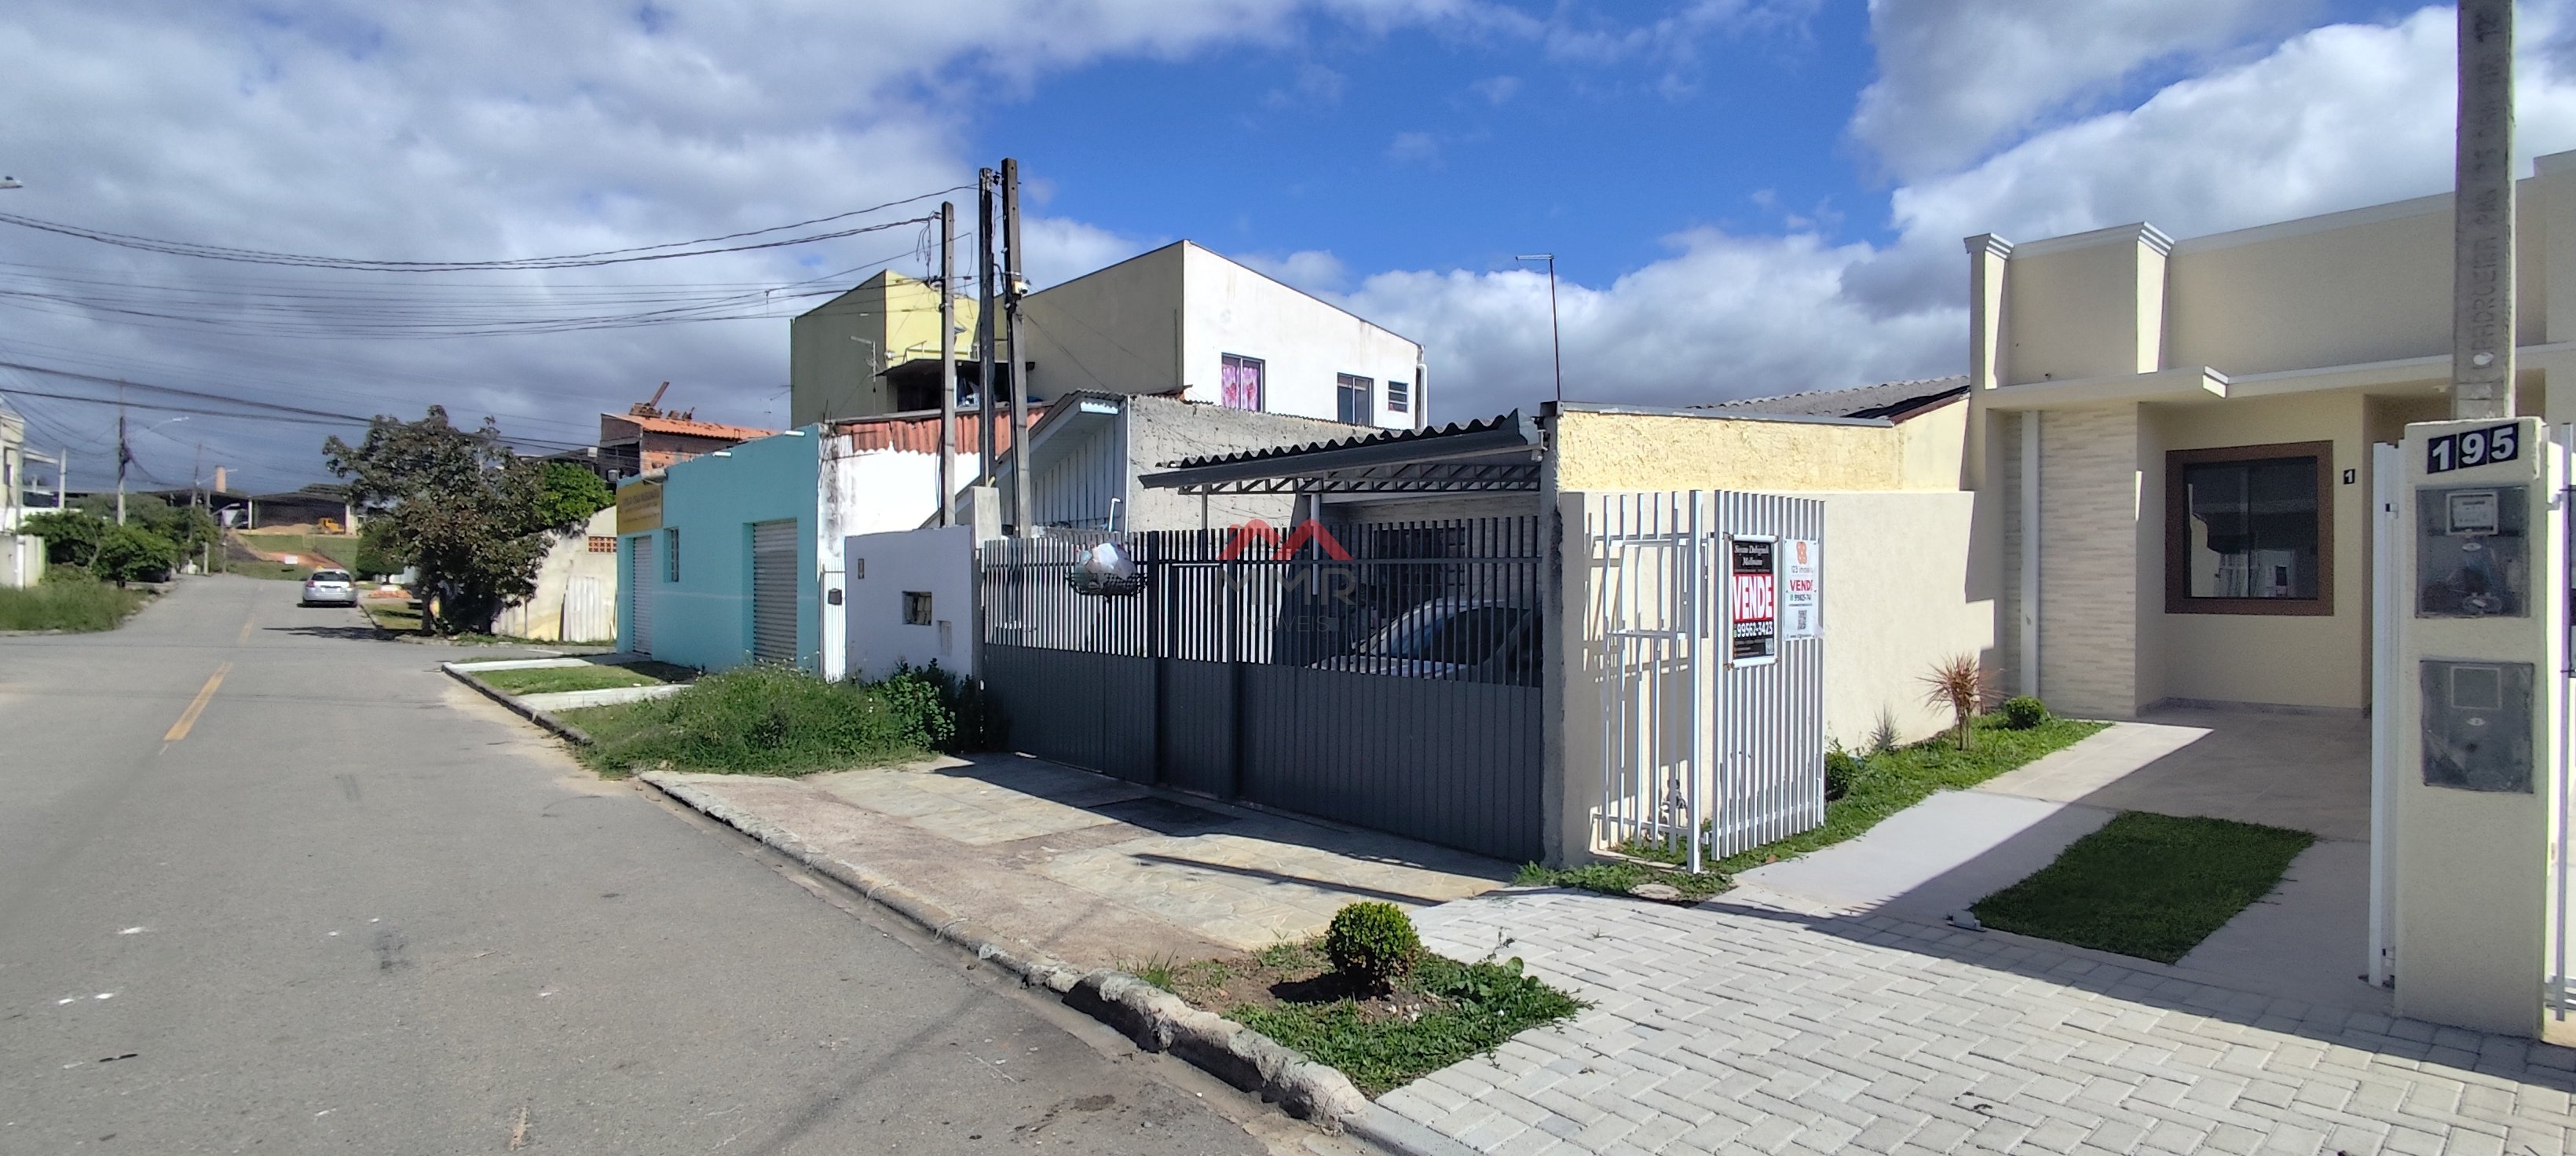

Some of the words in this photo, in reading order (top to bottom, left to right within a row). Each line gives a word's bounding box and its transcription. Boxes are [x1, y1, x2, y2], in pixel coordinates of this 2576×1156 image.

[2431, 427, 2515, 470] 195
[2345, 470, 2354, 483] 1
[1733, 576, 1773, 620] VENDE
